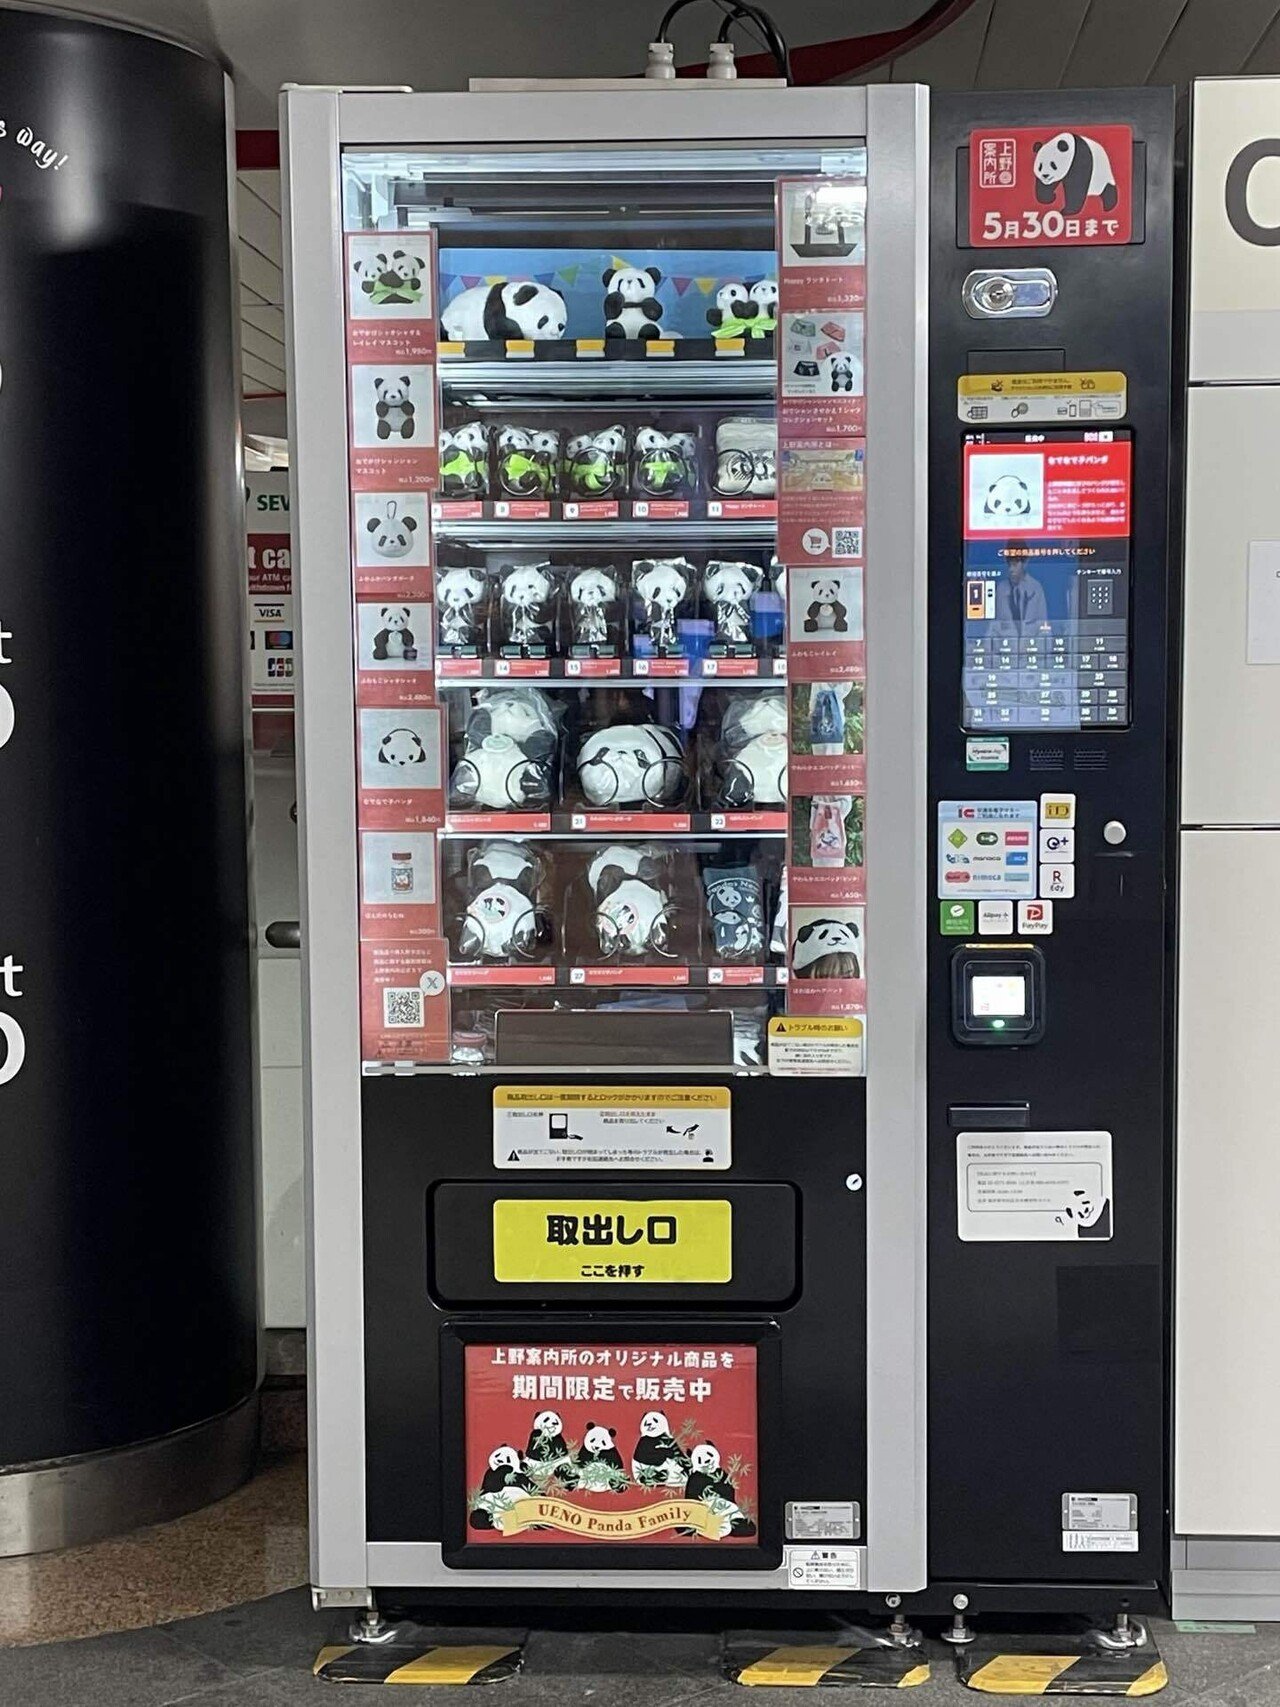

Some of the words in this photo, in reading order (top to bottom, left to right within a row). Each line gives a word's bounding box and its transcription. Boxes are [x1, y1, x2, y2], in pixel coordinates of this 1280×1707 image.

[16, 127, 69, 171] way!
[982, 210, 1119, 240] 5月30日まで
[259, 608, 282, 618] VISA
[546, 1214, 677, 1246] 取出し口
[581, 1265, 645, 1278] ここを押す
[491, 1348, 735, 1369] 上野案内所のオリジナル商品を
[511, 1375, 712, 1403] 期間限定で販売中
[538, 1504, 581, 1526] UENO
[588, 1518, 632, 1532] Panda
[638, 1507, 692, 1528] Family
